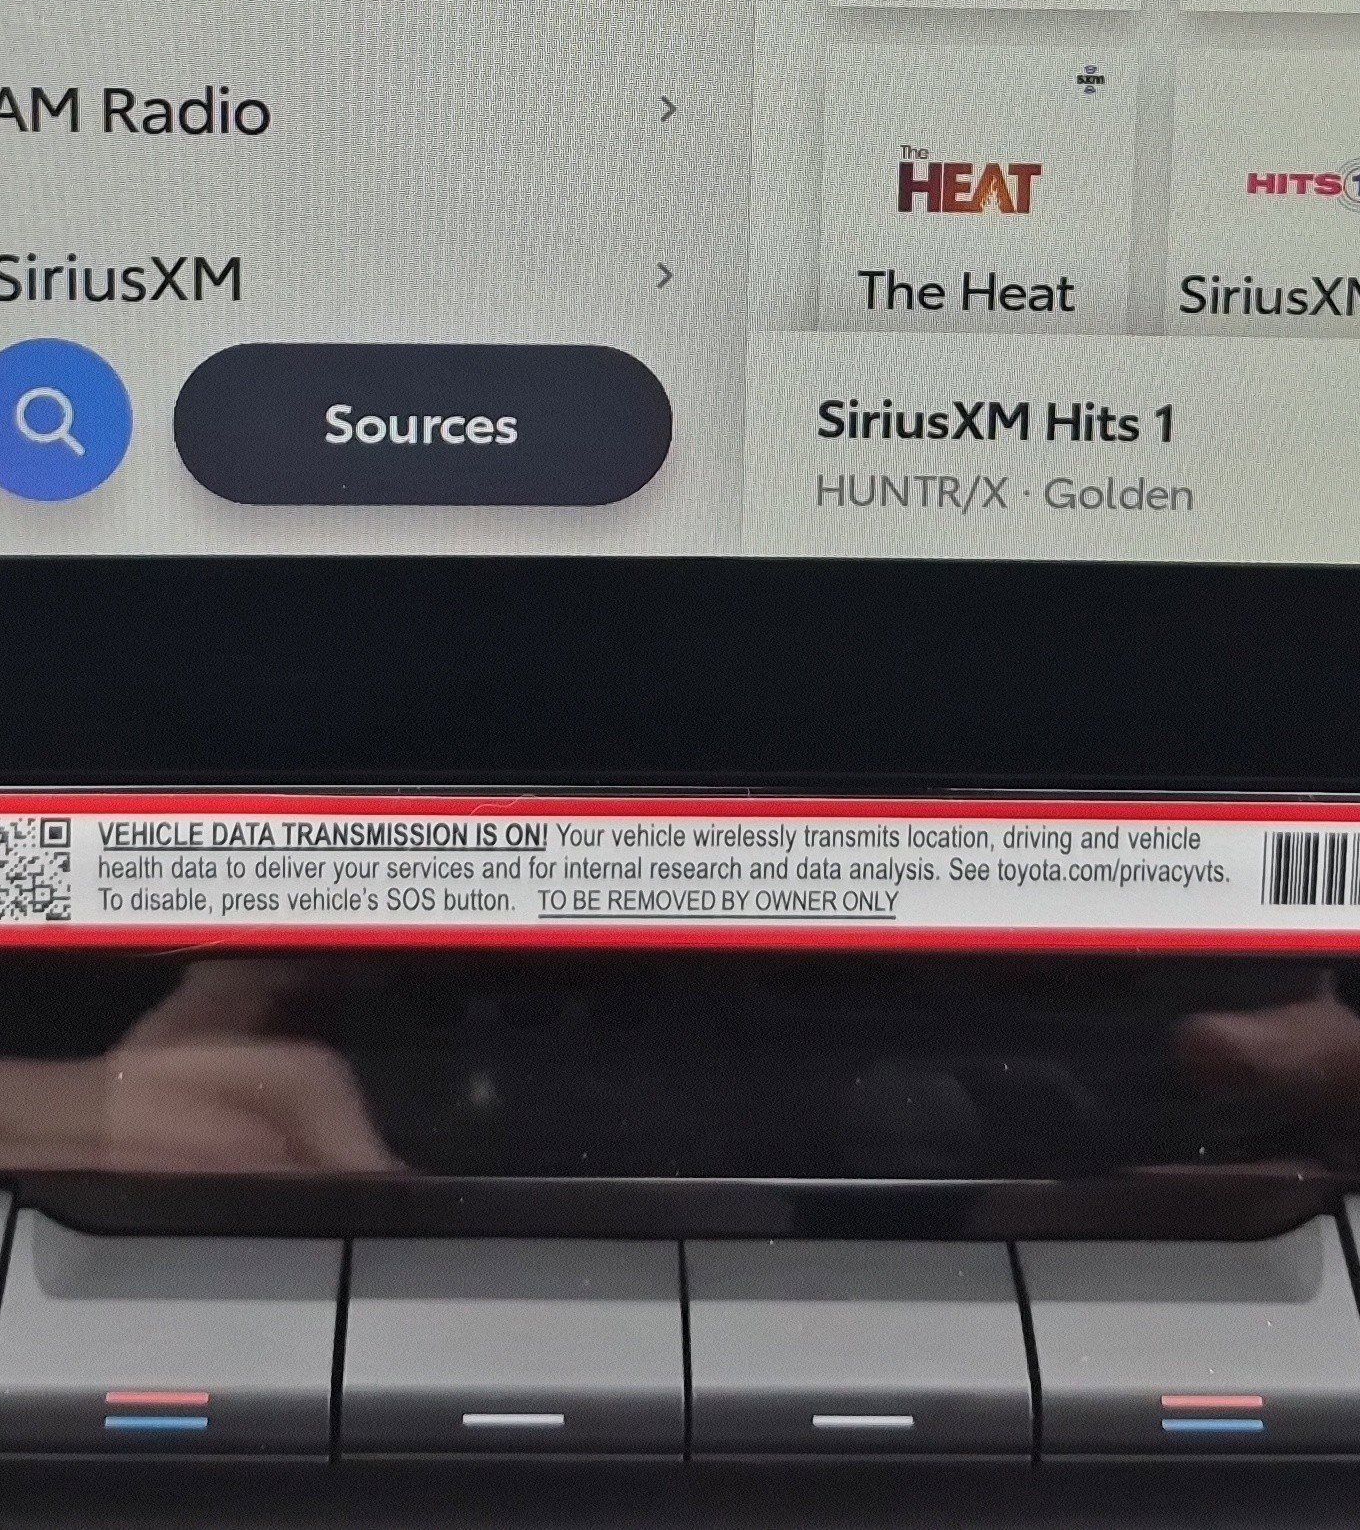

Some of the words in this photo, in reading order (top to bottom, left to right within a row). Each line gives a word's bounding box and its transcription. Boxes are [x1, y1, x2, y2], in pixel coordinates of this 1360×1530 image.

[103, 86, 270, 136] Radio
[900, 144, 929, 160] The
[898, 161, 1042, 214] HEAT
[857, 269, 946, 311] The
[962, 271, 1076, 312] Heat
[325, 405, 518, 445] Sources
[817, 399, 1029, 441] SiriusXM
[1046, 401, 1139, 442] Hits
[1155, 403, 1173, 442] 1
[817, 474, 1008, 515] HUNTR/X
[1044, 476, 1193, 511] Golden
[98, 821, 203, 846] VEHICLE
[213, 821, 275, 846] DATA
[282, 822, 467, 846] TRANSMISSION
[476, 822, 497, 846] IS
[505, 822, 548, 846] ON!
[556, 823, 605, 847] Your
[611, 823, 685, 847] vehicle
[693, 823, 796, 853] wirelessly
[804, 824, 900, 848] transmits
[908, 824, 995, 852] location,
[1003, 825, 1072, 855] driving
[1080, 826, 1120, 849] and
[1128, 826, 1201, 850] vehicle
[98, 855, 163, 879] health
[171, 855, 217, 879] data
[226, 857, 246, 879] to
[255, 855, 326, 879] deliver
[333, 861, 380, 884] your
[386, 856, 474, 879] services
[482, 856, 521, 879] and
[529, 856, 557, 879] for
[564, 856, 642, 880] internal
[650, 856, 741, 880] research
[749, 856, 788, 880] and
[796, 856, 841, 880] data
[849, 856, 940, 886] analysis.
[949, 857, 990, 881] See
[998, 858, 1230, 888] toyota.com/privacyvts.
[98, 887, 123, 911] To
[131, 887, 213, 914] disable,
[222, 891, 279, 916] press
[288, 887, 378, 911] vehicle's
[387, 887, 436, 911] SOS
[444, 888, 516, 911] button.
[538, 890, 566, 911] TO
[574, 890, 601, 911] BE
[609, 890, 716, 911] REMOVED
[722, 890, 750, 911] BY
[756, 890, 837, 911] OWNER
[843, 890, 899, 911] ONLY
